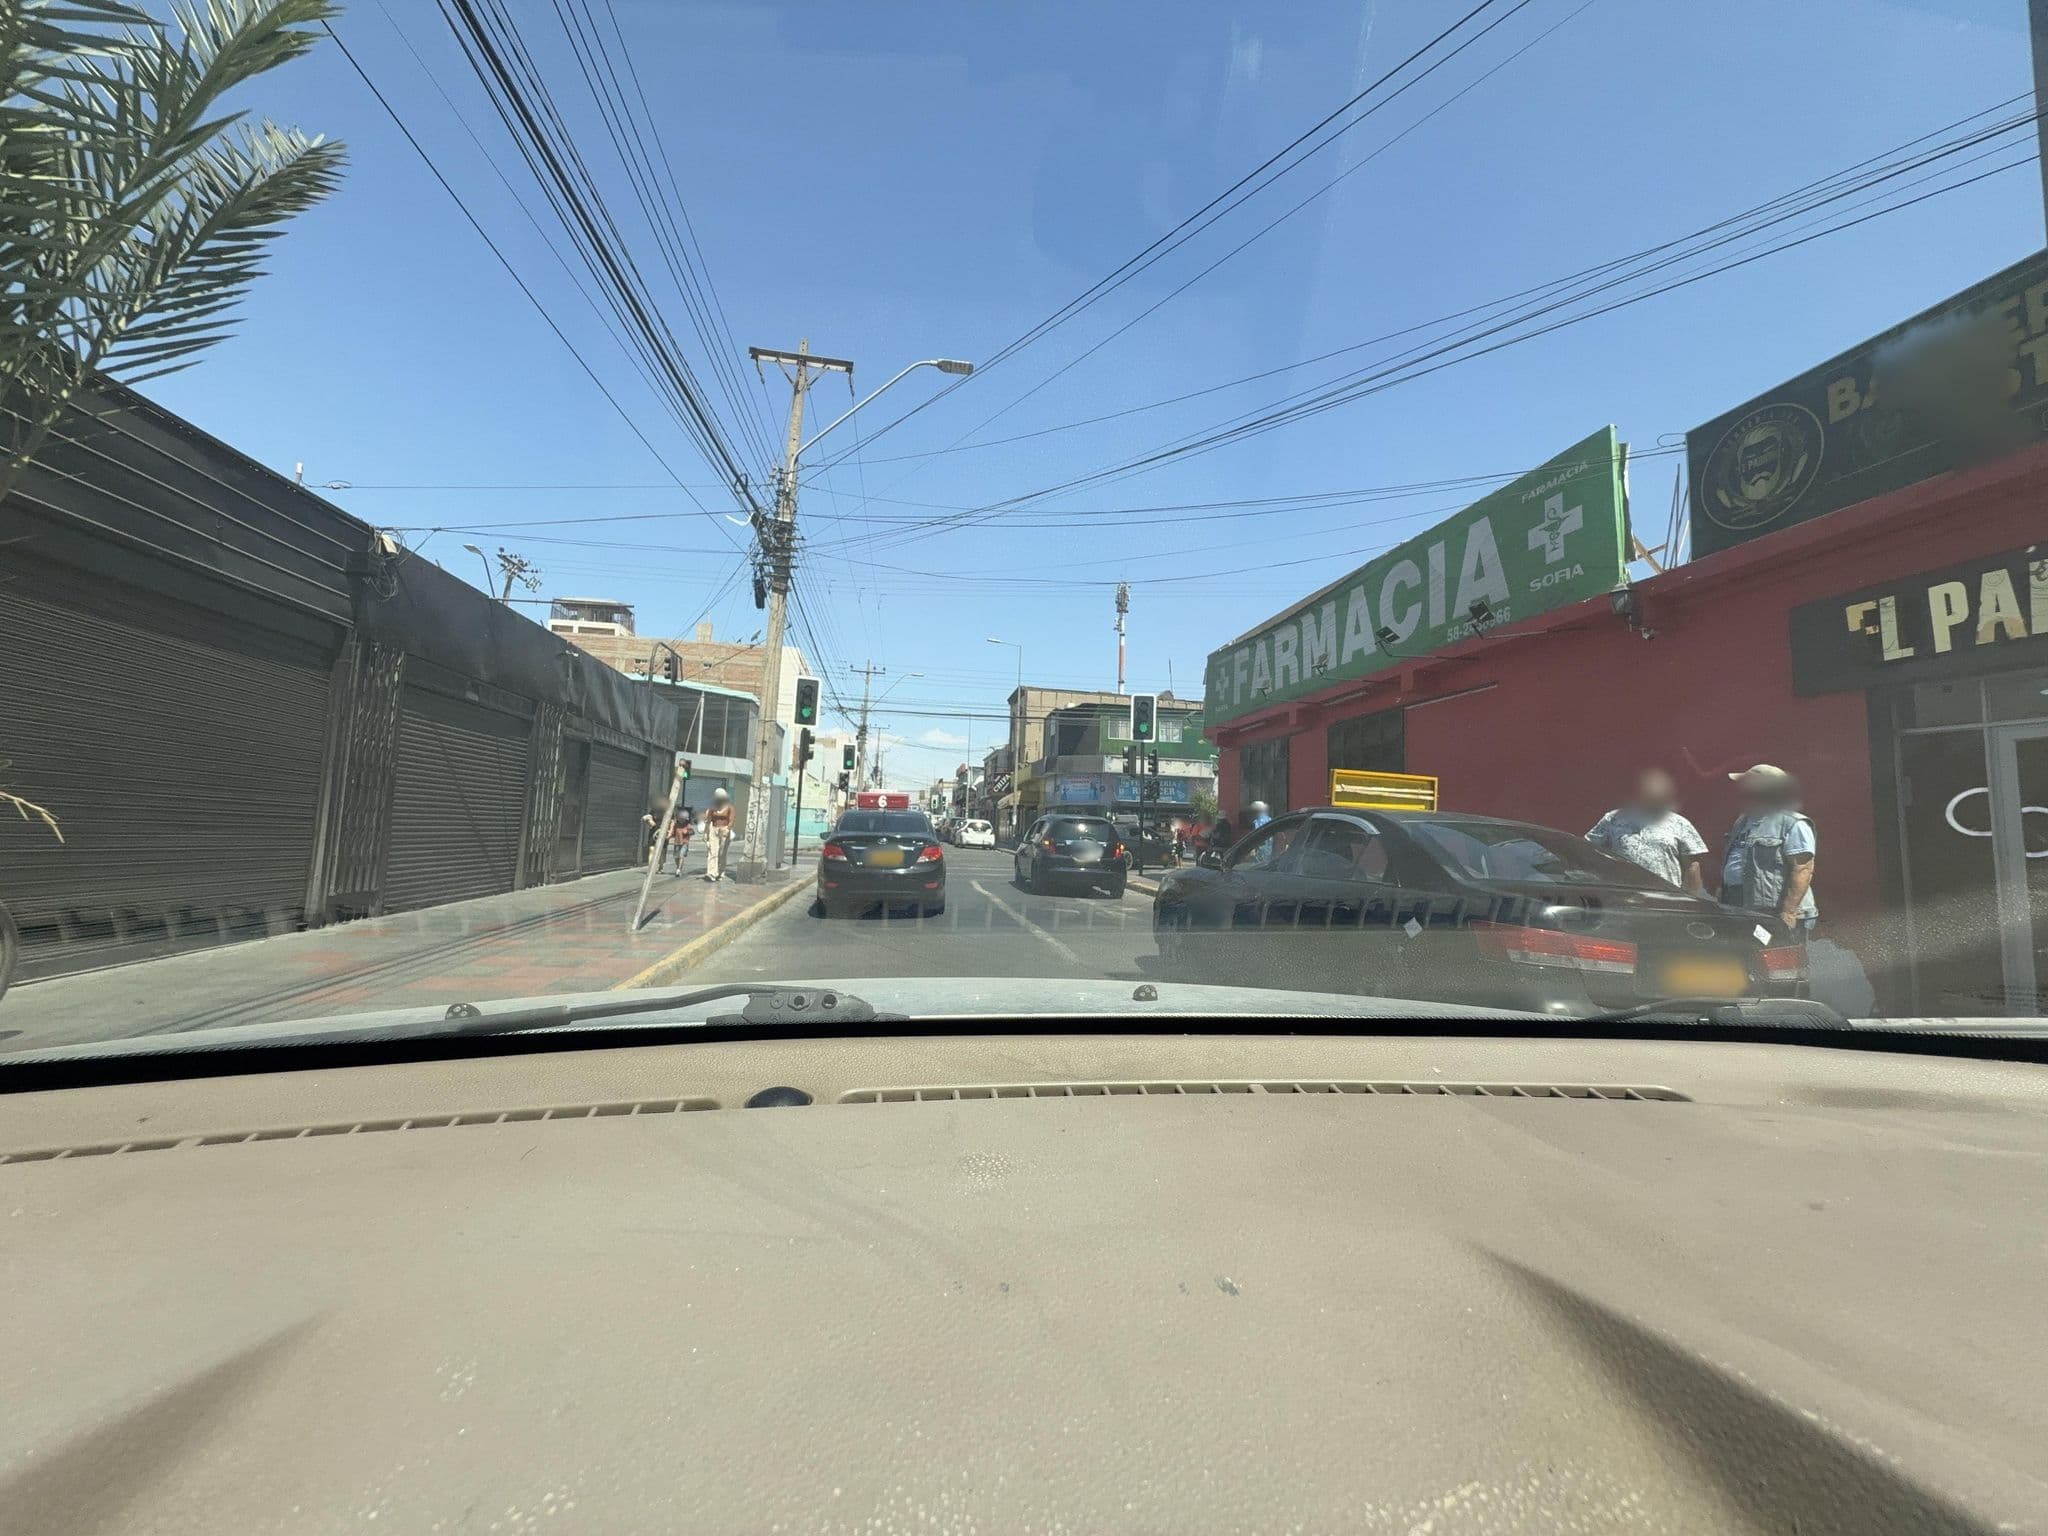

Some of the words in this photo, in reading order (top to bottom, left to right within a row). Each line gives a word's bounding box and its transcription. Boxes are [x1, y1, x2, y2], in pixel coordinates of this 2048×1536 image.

[1521, 461, 1589, 503] FARMACIA
[1529, 563, 1584, 592] SOFIA
[1233, 516, 1511, 705] FARMACIA
[878, 795, 888, 808] 6
